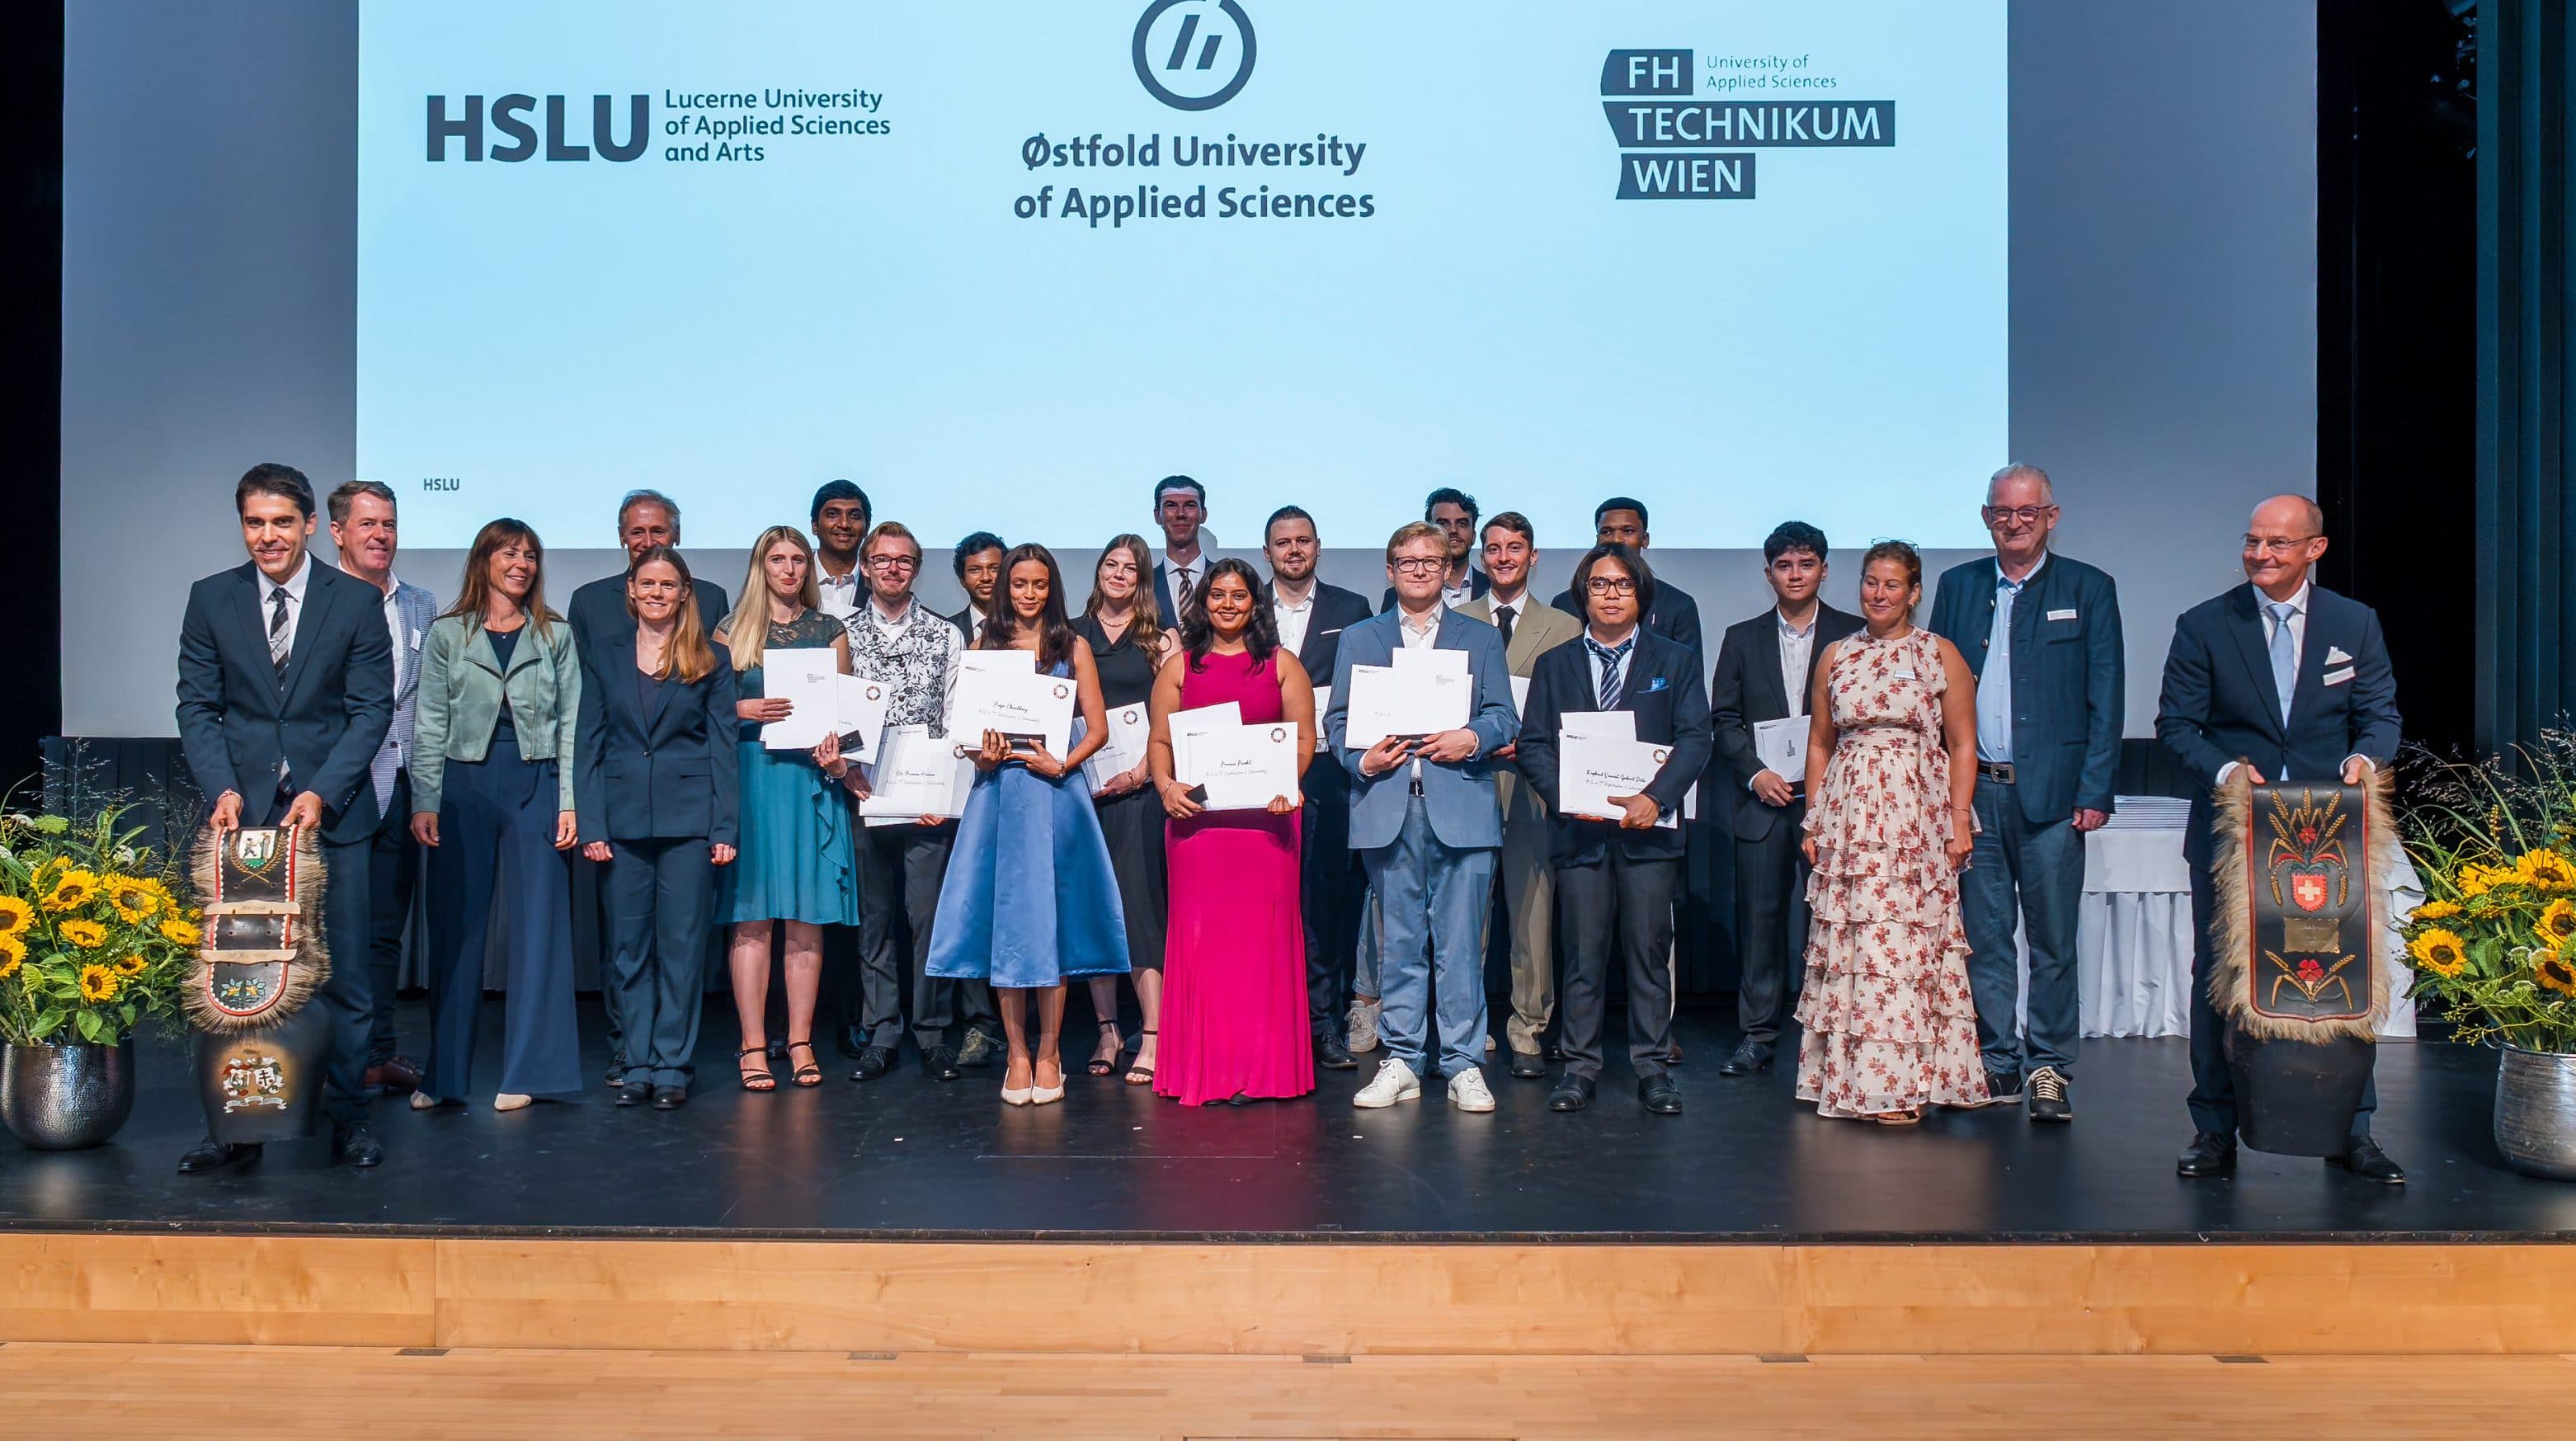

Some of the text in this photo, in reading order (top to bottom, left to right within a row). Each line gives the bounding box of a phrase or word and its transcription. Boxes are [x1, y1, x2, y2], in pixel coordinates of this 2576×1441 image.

[1628, 56, 1679, 88] FH
[1707, 54, 1809, 73] University of
[1706, 74, 1837, 92] Applied Sciences
[666, 88, 883, 114] Lucerne University
[426, 93, 650, 163] HSLU
[665, 114, 891, 140] of Applied Sciences
[1627, 106, 1881, 141] TECHNIKUM
[665, 141, 765, 162] and Arts
[1021, 131, 1367, 177] Østfold University
[1632, 159, 1741, 193] WIEN
[1014, 184, 1375, 228] of Applied Sciences
[423, 478, 460, 492] HSLU
